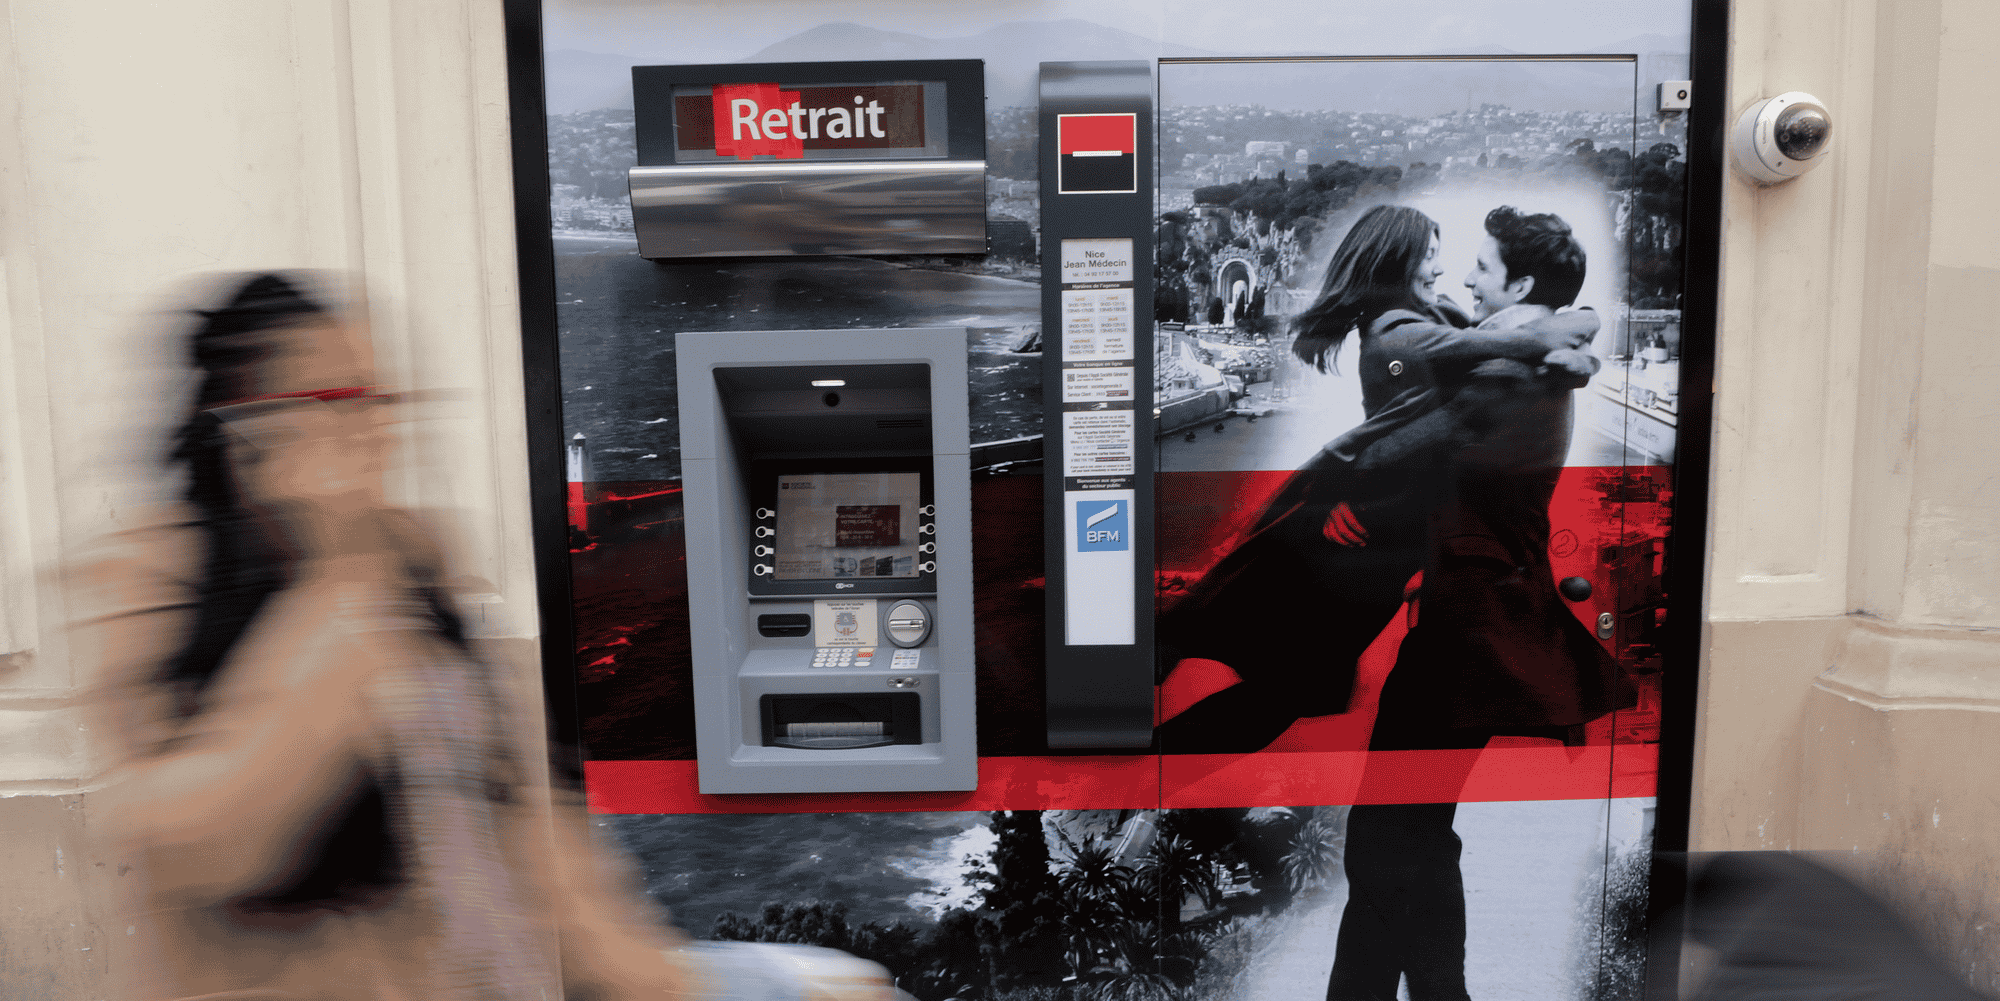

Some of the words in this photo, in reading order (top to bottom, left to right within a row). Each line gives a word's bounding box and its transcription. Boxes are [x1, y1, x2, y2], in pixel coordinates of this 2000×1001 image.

[731, 95, 886, 140] Retrait
[1085, 250, 1105, 258] Nice
[1088, 259, 1127, 268] Médecin
[1087, 530, 1119, 542] BFM
